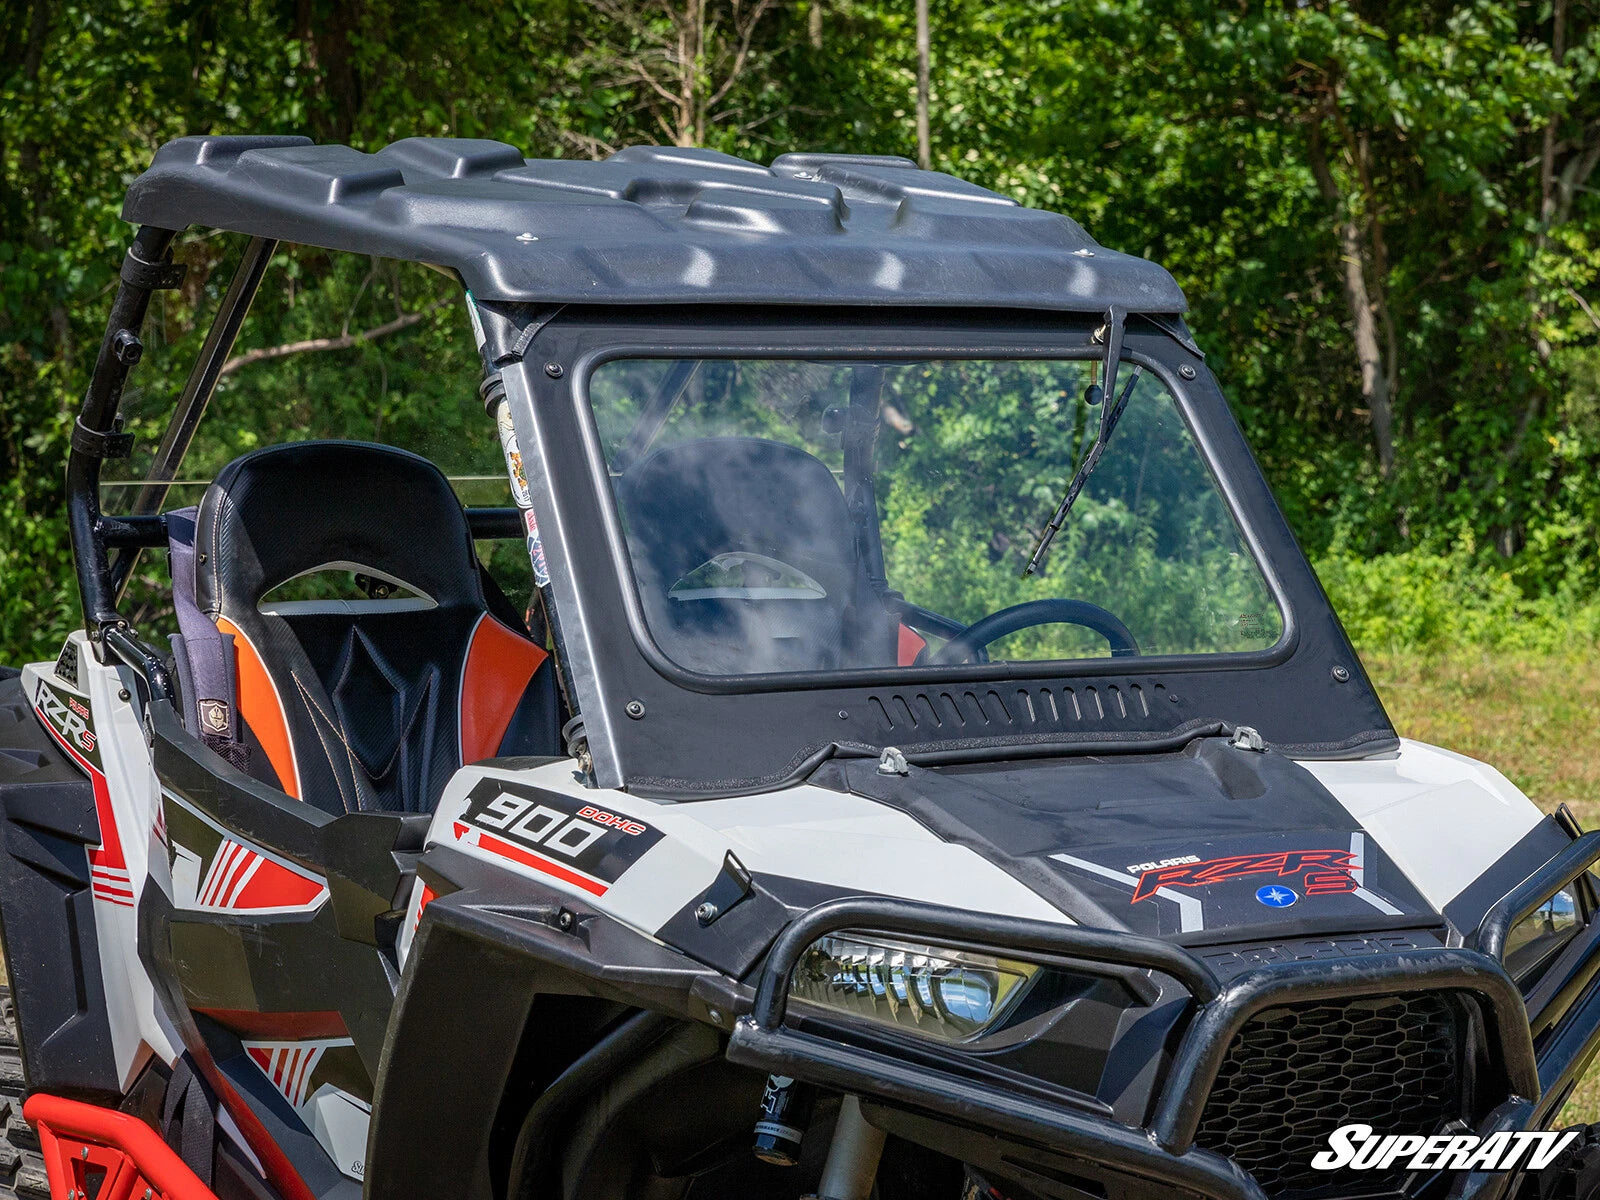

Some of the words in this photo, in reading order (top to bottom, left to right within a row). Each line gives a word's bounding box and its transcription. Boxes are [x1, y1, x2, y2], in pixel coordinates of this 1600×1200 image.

[475, 791, 608, 858] 900
[576, 805, 647, 836] DOHC
[1126, 854, 1202, 875] POLARIS
[1130, 849, 1364, 905] RZR
